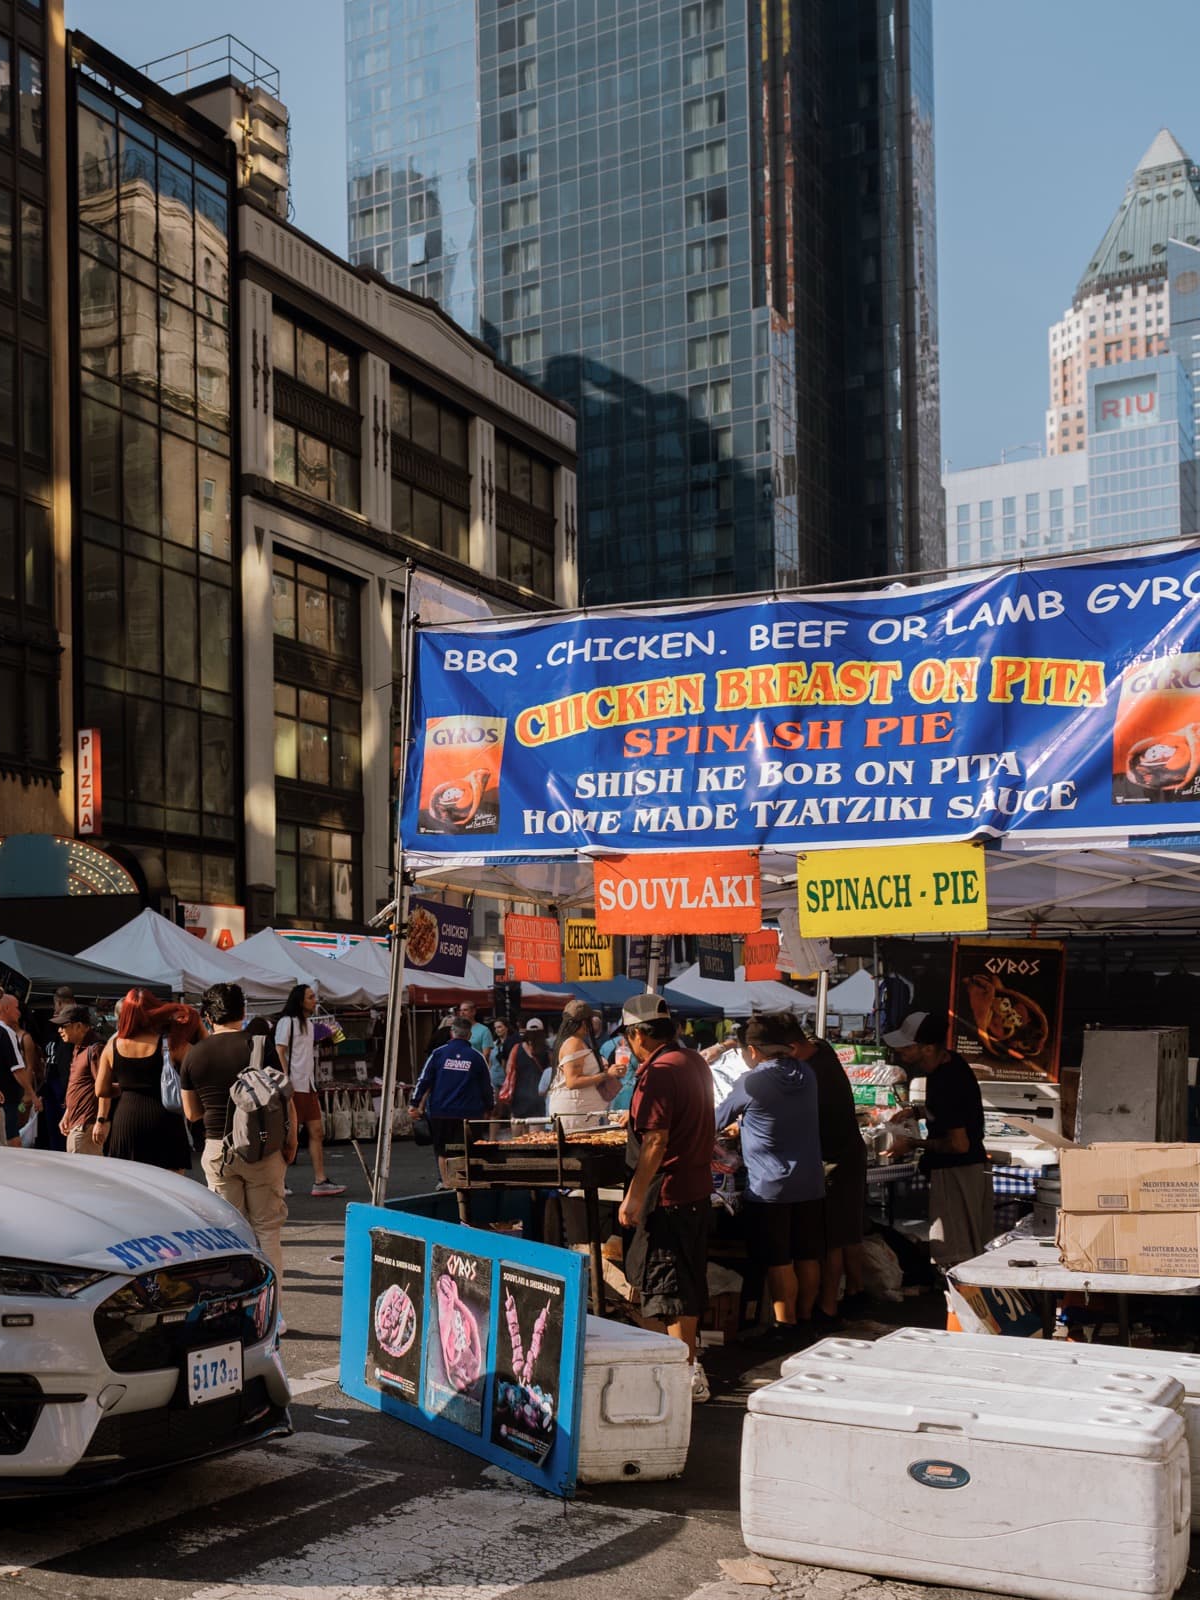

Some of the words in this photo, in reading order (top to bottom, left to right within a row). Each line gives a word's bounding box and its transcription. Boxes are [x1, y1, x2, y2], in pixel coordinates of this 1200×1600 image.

[1102, 391, 1155, 420] RIU
[443, 649, 518, 676] BBQ
[750, 620, 849, 652] BEEF
[868, 616, 928, 645] OR
[945, 590, 1065, 636] LAMB
[514, 673, 706, 748] CHICKEN
[715, 658, 903, 711] BREAST
[908, 656, 981, 705] ON
[988, 655, 1107, 707] PITA
[433, 727, 498, 746] GYROS
[623, 719, 844, 758] SPINASH
[864, 711, 955, 748] PIE
[80, 735, 92, 828] PIZZA
[575, 768, 684, 799] SHISH
[696, 765, 747, 792] KE
[758, 761, 842, 788] BOB
[855, 760, 915, 785] ON
[929, 751, 1021, 785] PITA
[522, 809, 621, 835] HOME
[632, 803, 738, 833] MADE
[749, 796, 933, 829] TZATZIKI
[947, 780, 1078, 820] SAUCE
[599, 875, 756, 911] SOUVLAKI
[806, 873, 913, 913] SPINACH
[932, 870, 980, 906] PIE
[441, 922, 469, 940] CHICKEN
[567, 925, 611, 949] CHICKEN
[439, 941, 464, 958] KE-BOB
[578, 953, 601, 976] PITA
[984, 957, 1040, 975] GYROS
[444, 1059, 472, 1069] GIANTS
[105, 1234, 182, 1270] NYPD
[171, 1228, 250, 1252] POLICE
[446, 1254, 477, 1280] GYROS
[503, 1272, 525, 1286] SOUVLAKI
